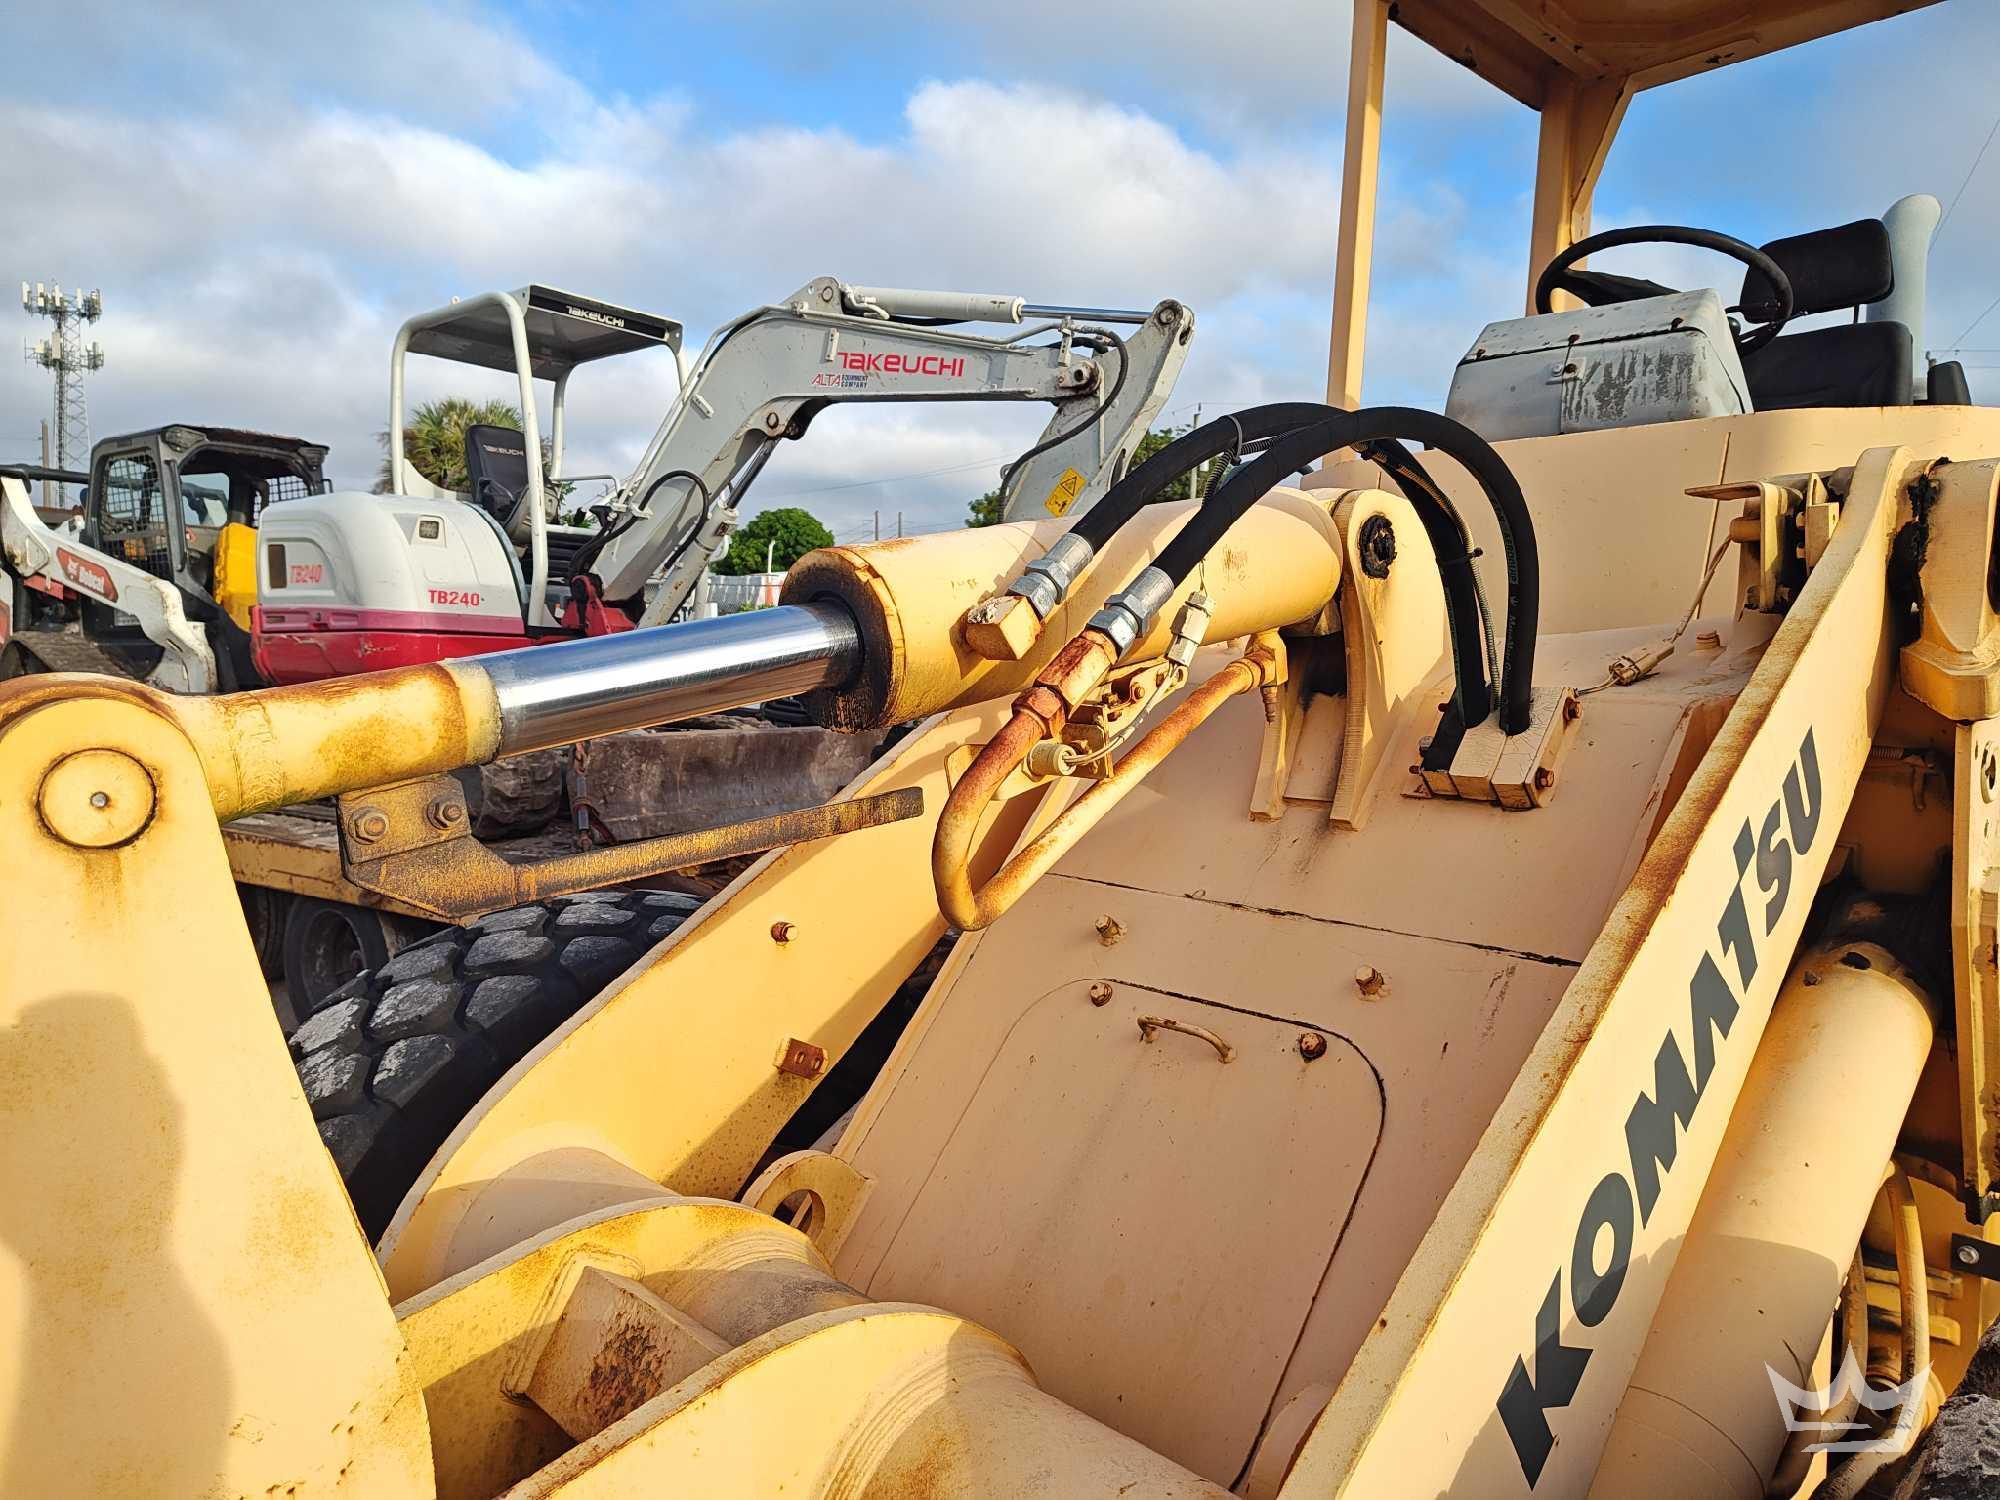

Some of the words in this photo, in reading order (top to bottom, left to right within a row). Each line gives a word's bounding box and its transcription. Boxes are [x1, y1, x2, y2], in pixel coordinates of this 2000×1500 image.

[566, 305, 625, 328] TAKEUCHI
[837, 352, 965, 377] TAKEUCHI
[811, 374, 841, 386] ALTA
[291, 564, 322, 584] TB240
[428, 589, 481, 606] TB240
[1496, 724, 1822, 1492] KOMATSU
